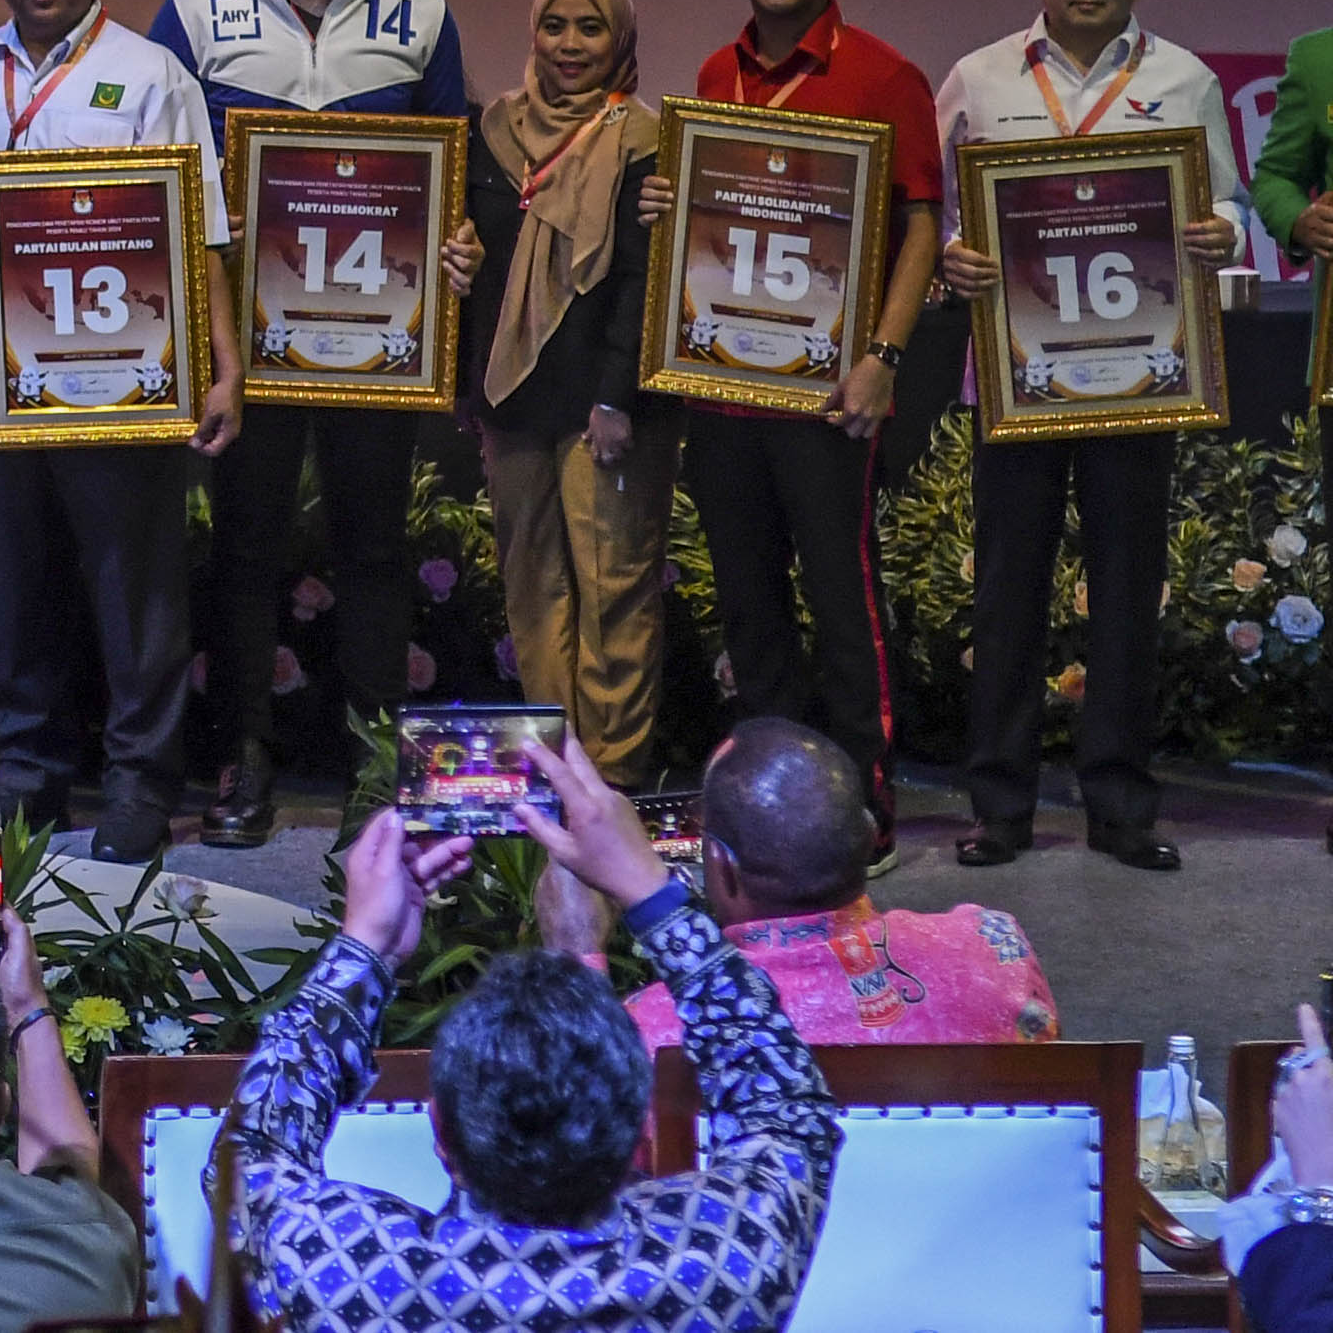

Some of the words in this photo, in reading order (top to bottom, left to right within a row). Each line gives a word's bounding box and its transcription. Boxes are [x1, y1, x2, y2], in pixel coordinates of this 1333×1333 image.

[221, 8, 251, 24] AHY
[287, 201, 331, 214] PARTAI
[332, 204, 399, 217] DEMOKRAT
[714, 190, 757, 205] PARTAI
[758, 196, 832, 216] SOLIDARITAS
[741, 206, 803, 224] INDONESIA
[1037, 227, 1083, 240] PARTAI
[1084, 222, 1139, 236] PERINDO
[14, 243, 59, 255] PARTAI
[59, 241, 99, 253] BULAN
[100, 239, 154, 252] BINTANG
[297, 226, 388, 295] 14
[727, 227, 812, 302] 15
[1044, 251, 1140, 323] 16
[43, 265, 129, 336] 13
